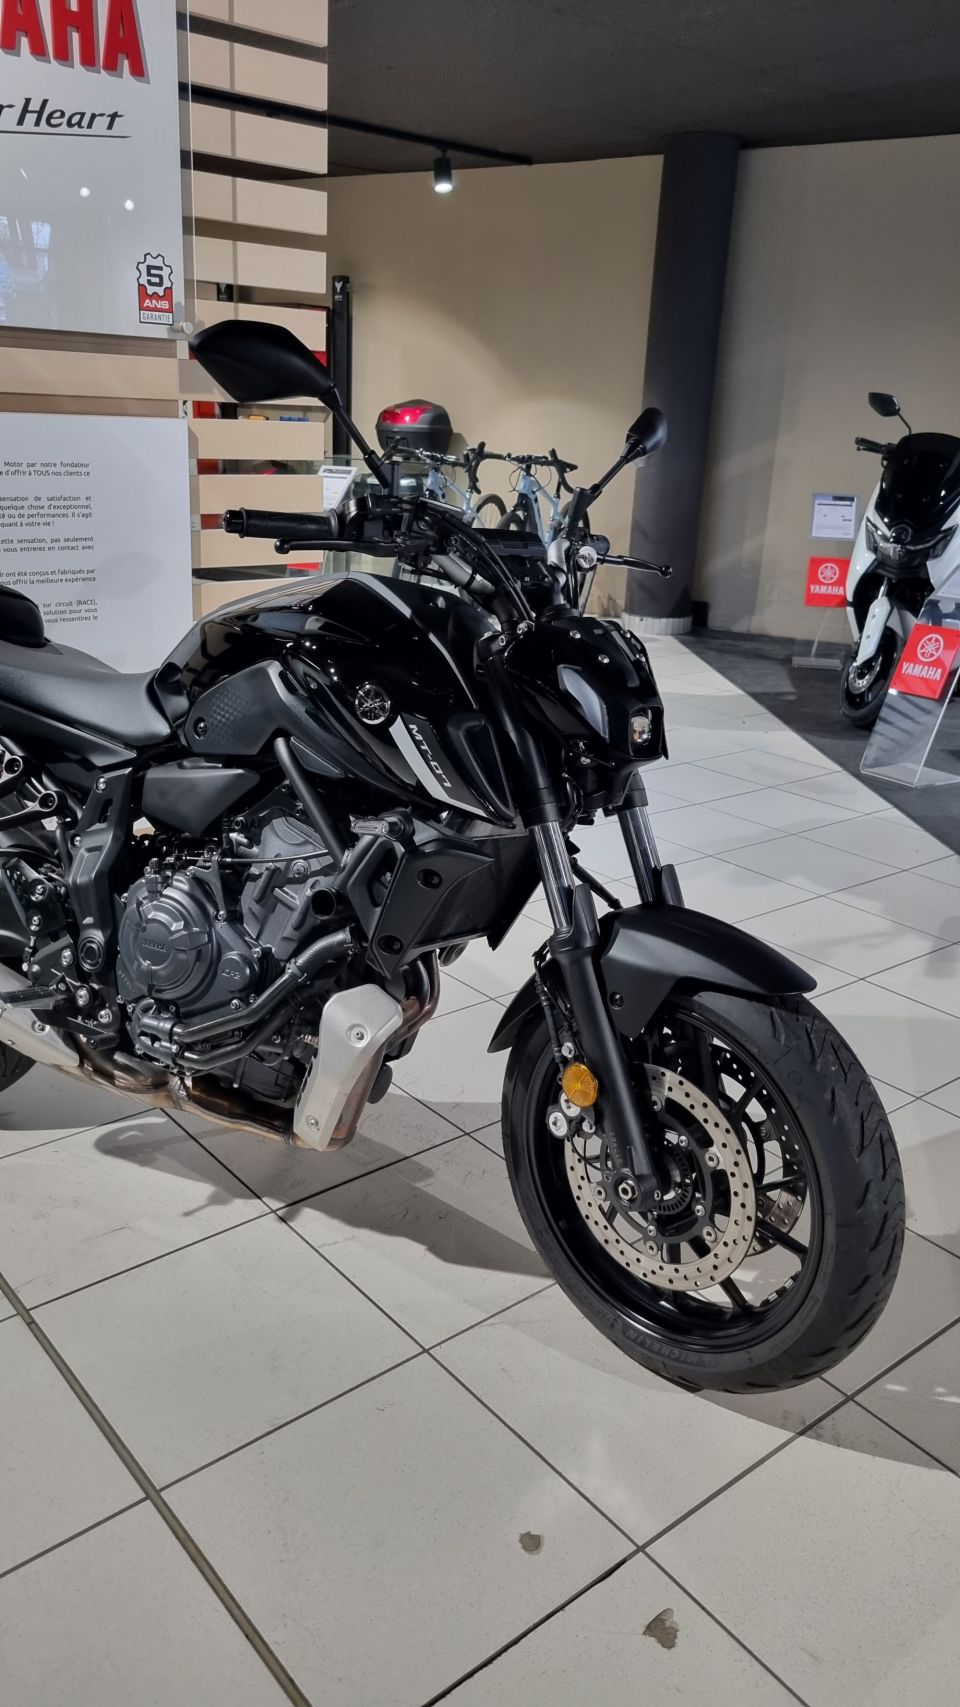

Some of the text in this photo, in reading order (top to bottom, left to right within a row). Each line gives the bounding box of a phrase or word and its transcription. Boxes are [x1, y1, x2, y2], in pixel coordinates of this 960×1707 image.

[16, 98, 124, 130] Heart
[146, 265, 163, 287] 5
[144, 300, 169, 309] ANS
[142, 313, 171, 322] GARANTIE
[810, 584, 844, 596] YAMAHA
[901, 661, 943, 680] YAMAHA
[408, 724, 451, 787] MT-07
[624, 1327, 700, 1365] MICHELIN
